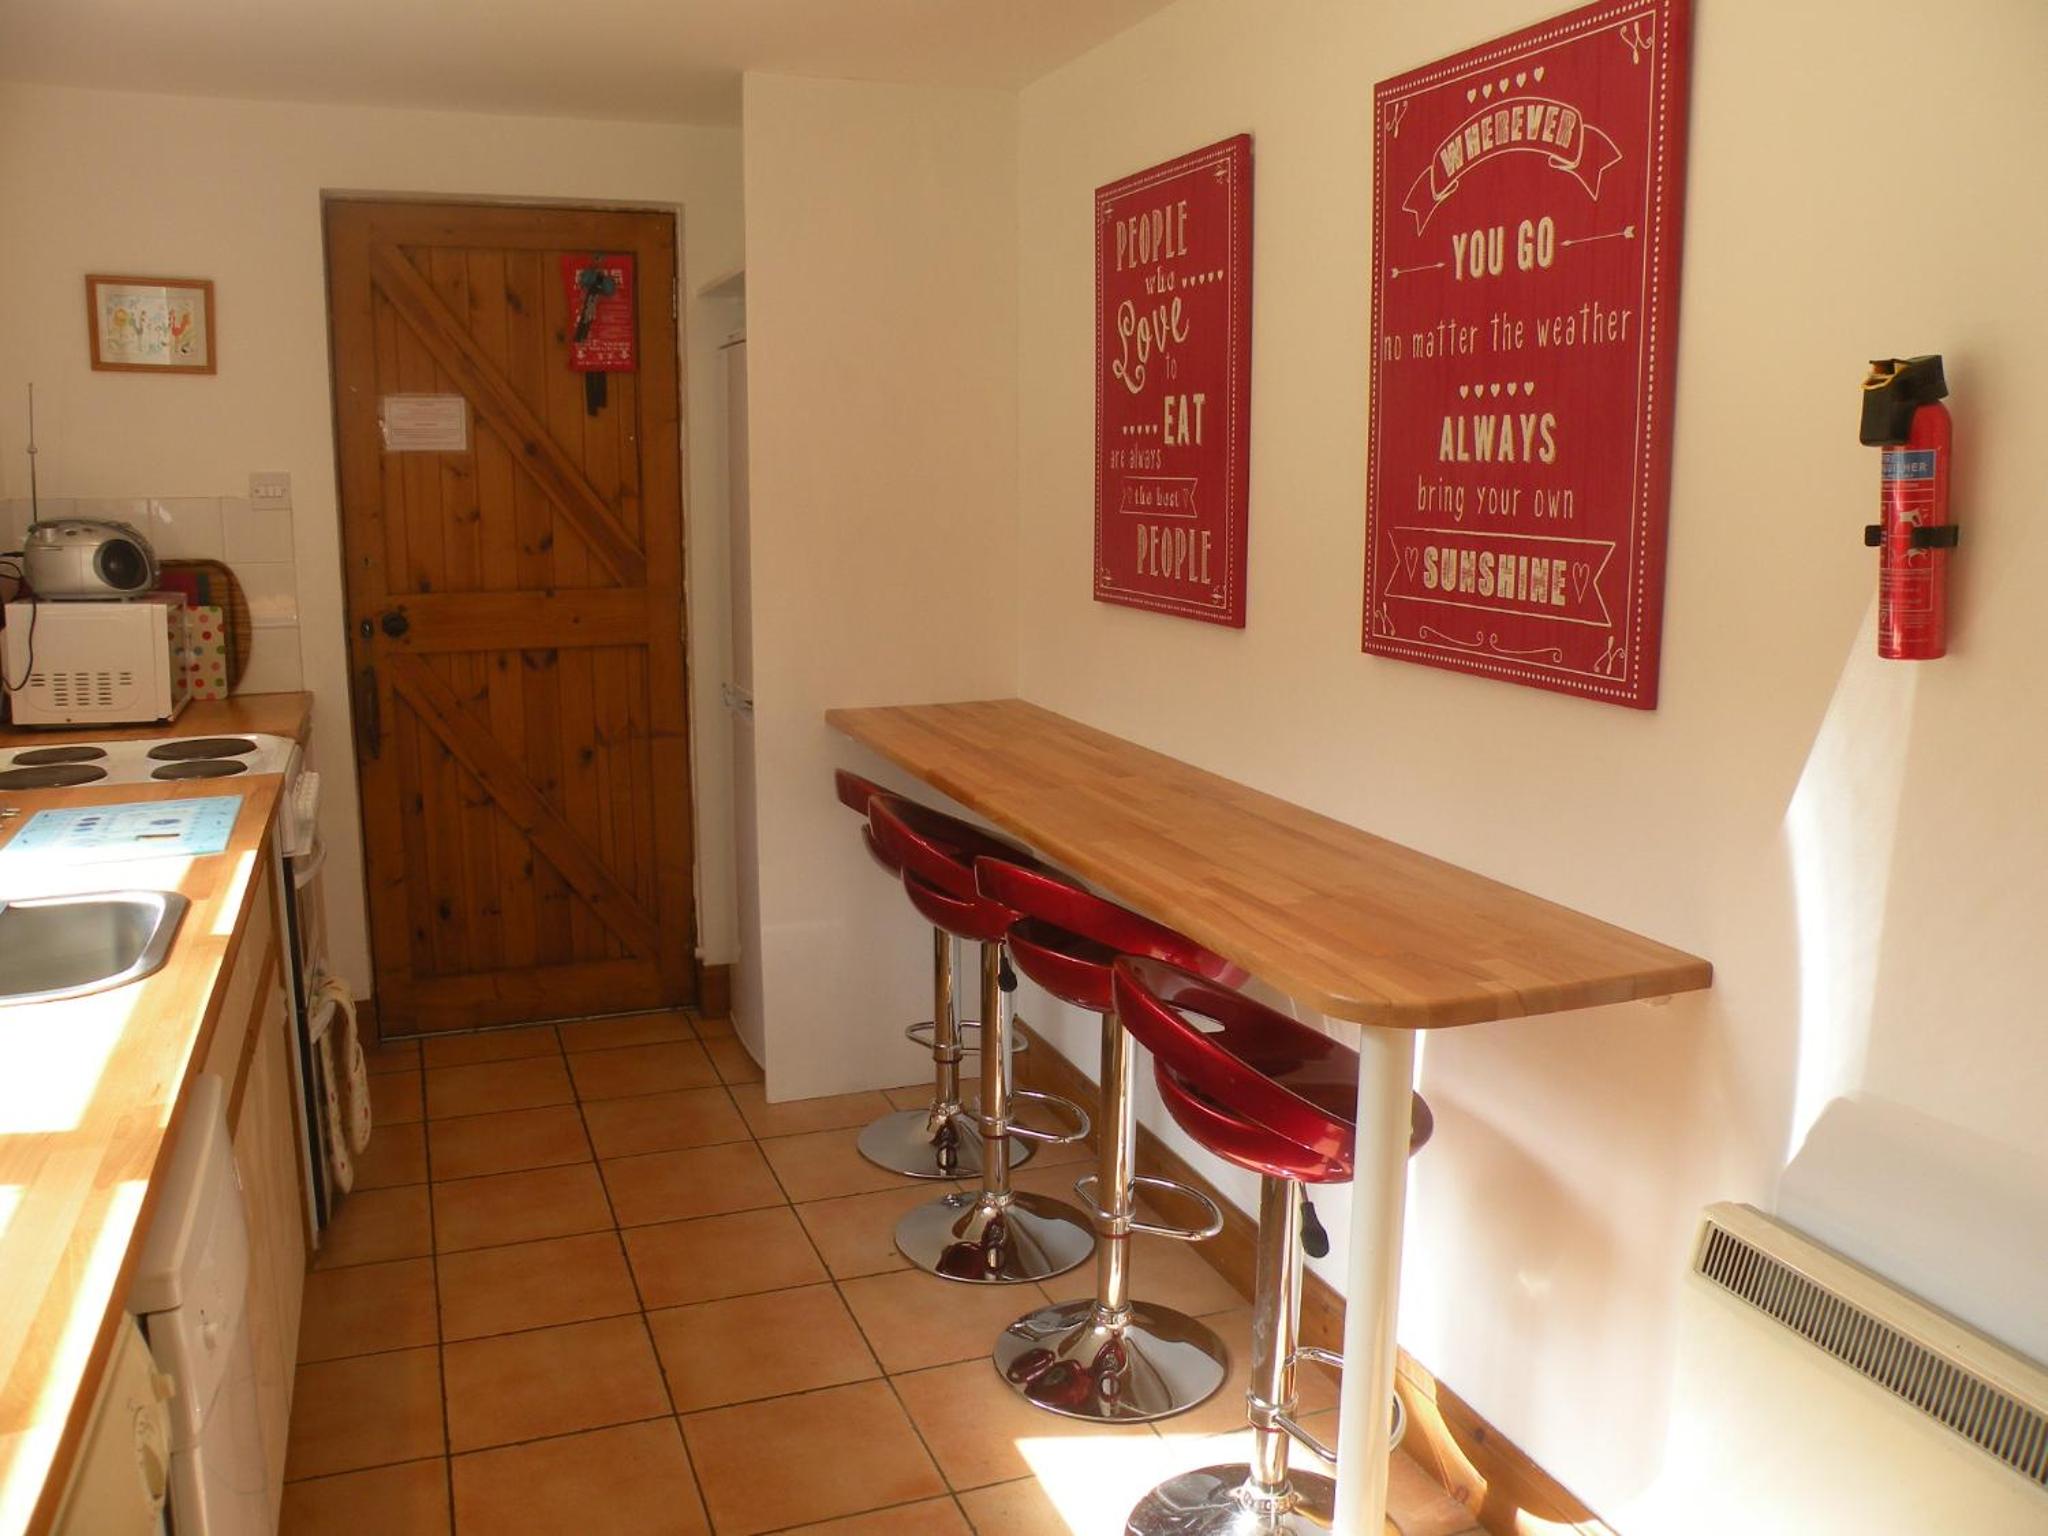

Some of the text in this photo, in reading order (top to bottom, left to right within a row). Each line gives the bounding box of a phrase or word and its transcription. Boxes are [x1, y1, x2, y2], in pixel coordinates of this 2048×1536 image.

[1440, 104, 1577, 178] WHEREVER
[1116, 200, 1188, 272] PEOPLE
[1452, 216, 1555, 281] YOU GO
[1145, 266, 1175, 295] who
[1112, 297, 1190, 395] Love
[1384, 301, 1633, 362] no matter the weather
[1164, 351, 1178, 381] to
[1163, 392, 1206, 446] EAT
[1439, 412, 1557, 465] ALWAYS
[1110, 442, 1162, 470] are always
[1135, 485, 1179, 508] the best
[1418, 475, 1575, 522] bring your own
[1137, 523, 1212, 585] PEOPLE
[1423, 545, 1568, 606] SUNSHINE
